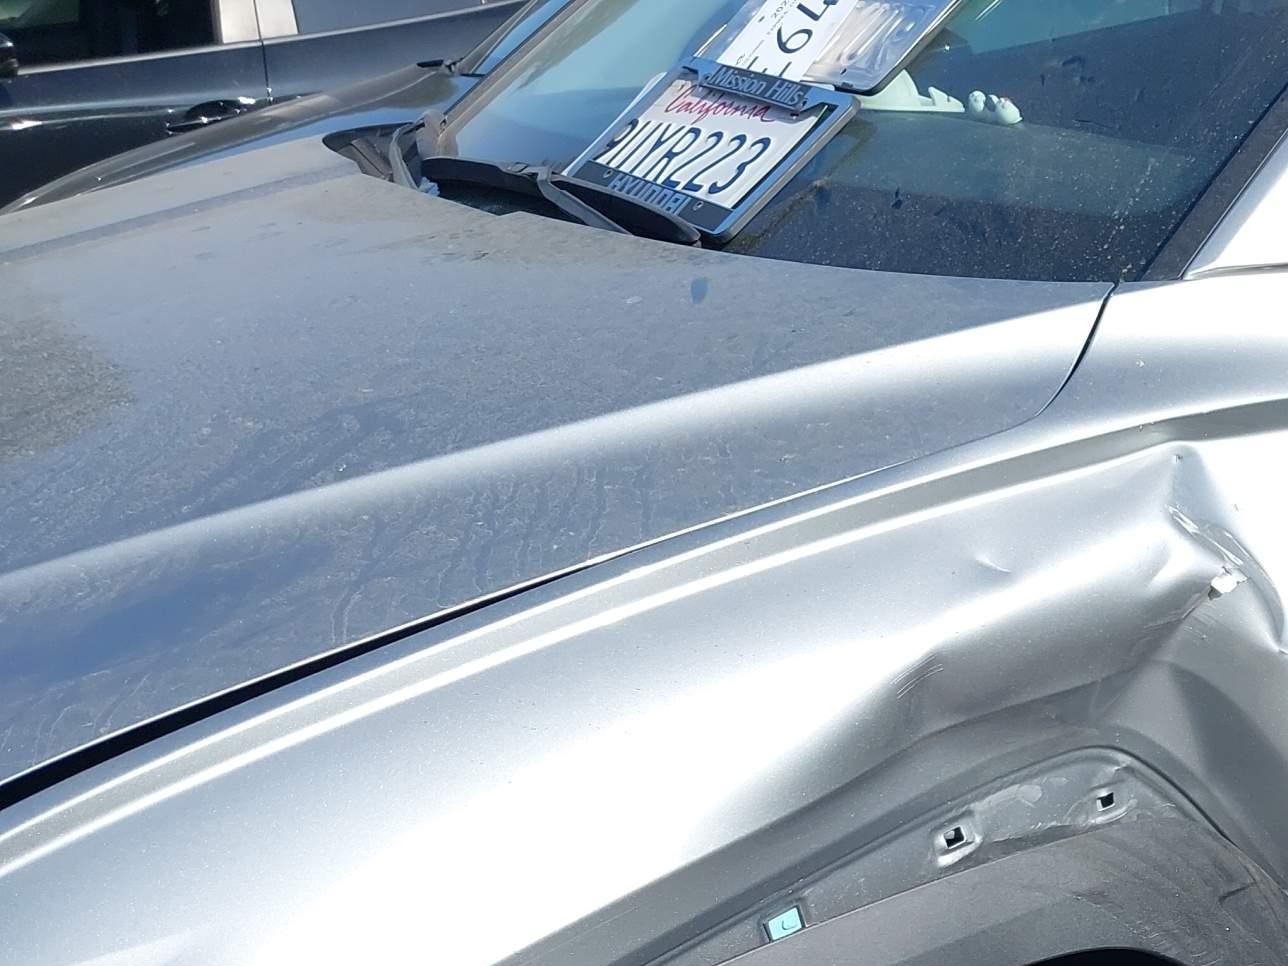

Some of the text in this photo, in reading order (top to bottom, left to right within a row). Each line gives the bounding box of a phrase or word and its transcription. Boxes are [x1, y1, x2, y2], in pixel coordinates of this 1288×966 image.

[664, 84, 775, 125] California
[709, 67, 806, 105] Mission Hills
[608, 174, 692, 215] HYUNDAI
